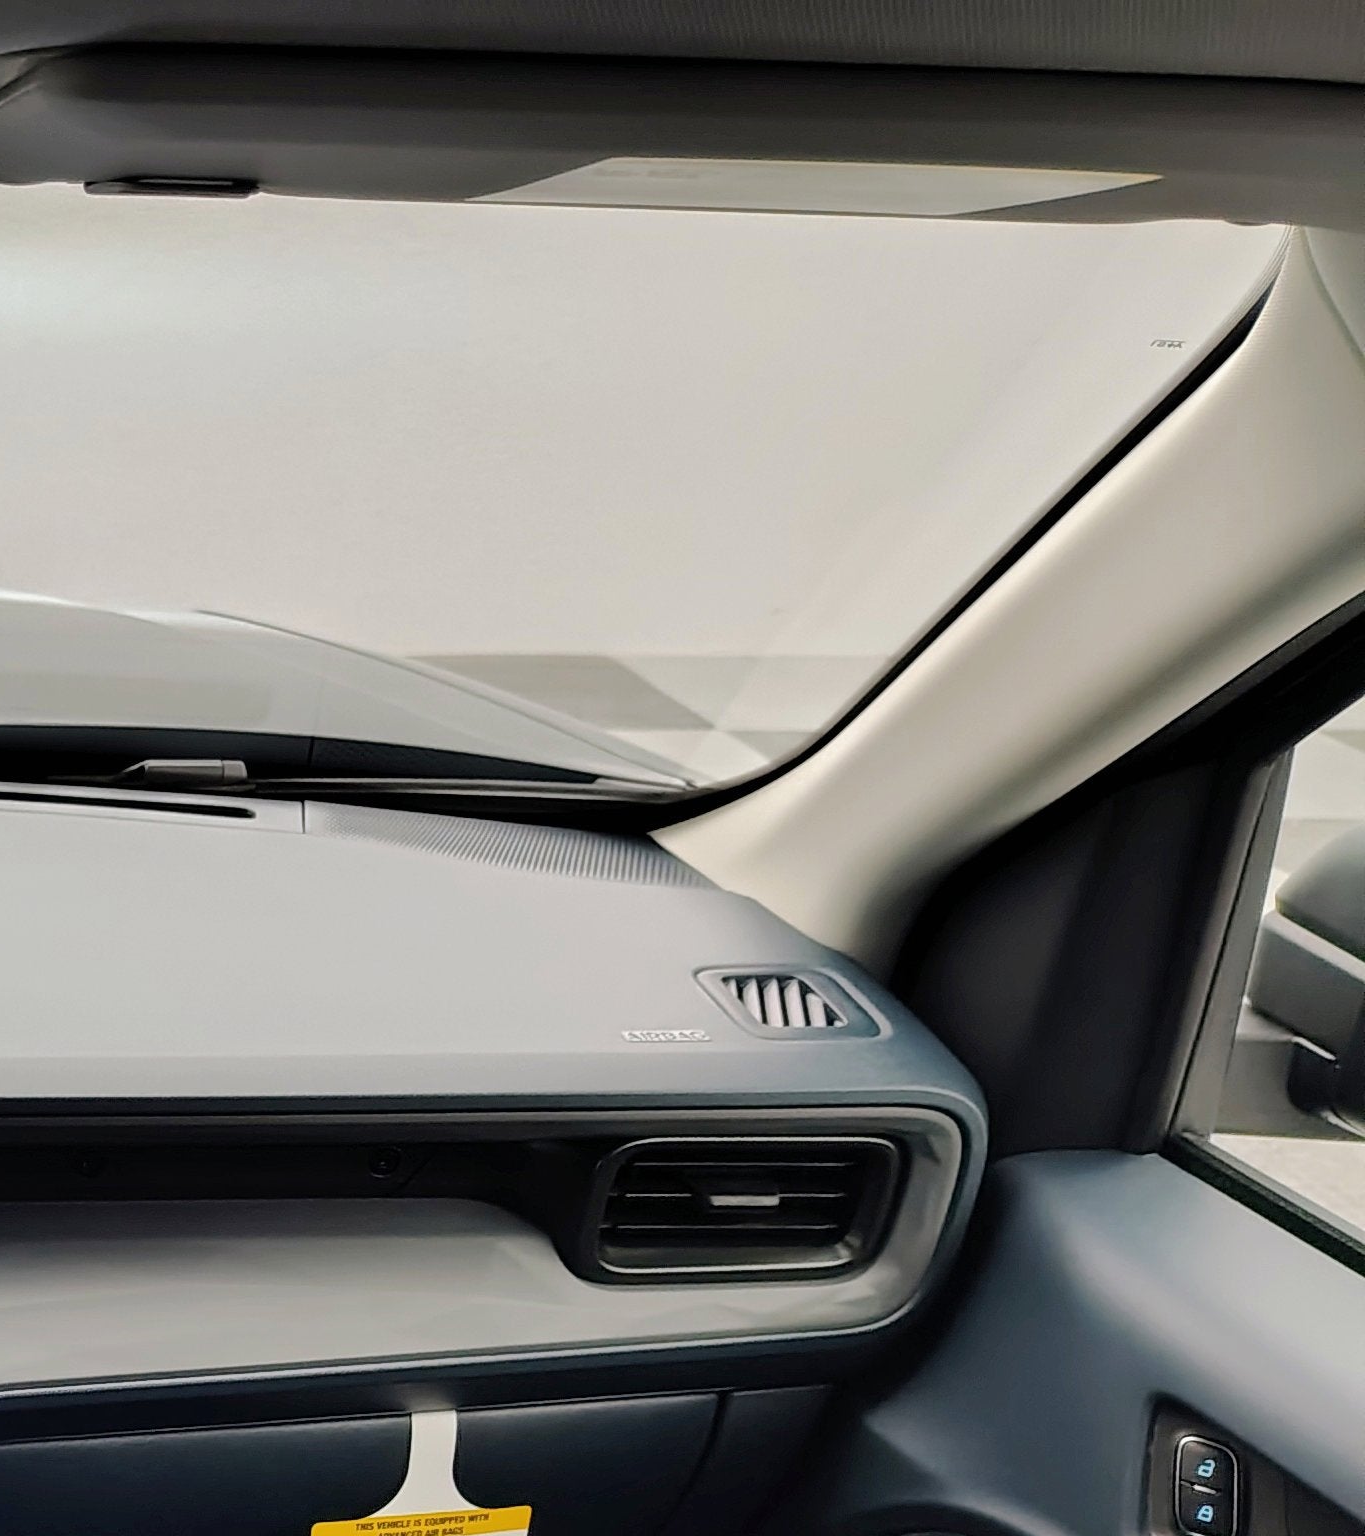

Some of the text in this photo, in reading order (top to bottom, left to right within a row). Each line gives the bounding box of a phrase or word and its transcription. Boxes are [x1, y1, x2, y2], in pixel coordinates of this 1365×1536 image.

[356, 1512, 489, 1532] THIS VEHICLE IS EQUIPPED WITH
[424, 1528, 439, 1536] AIR
[441, 1526, 463, 1535] BAGS
